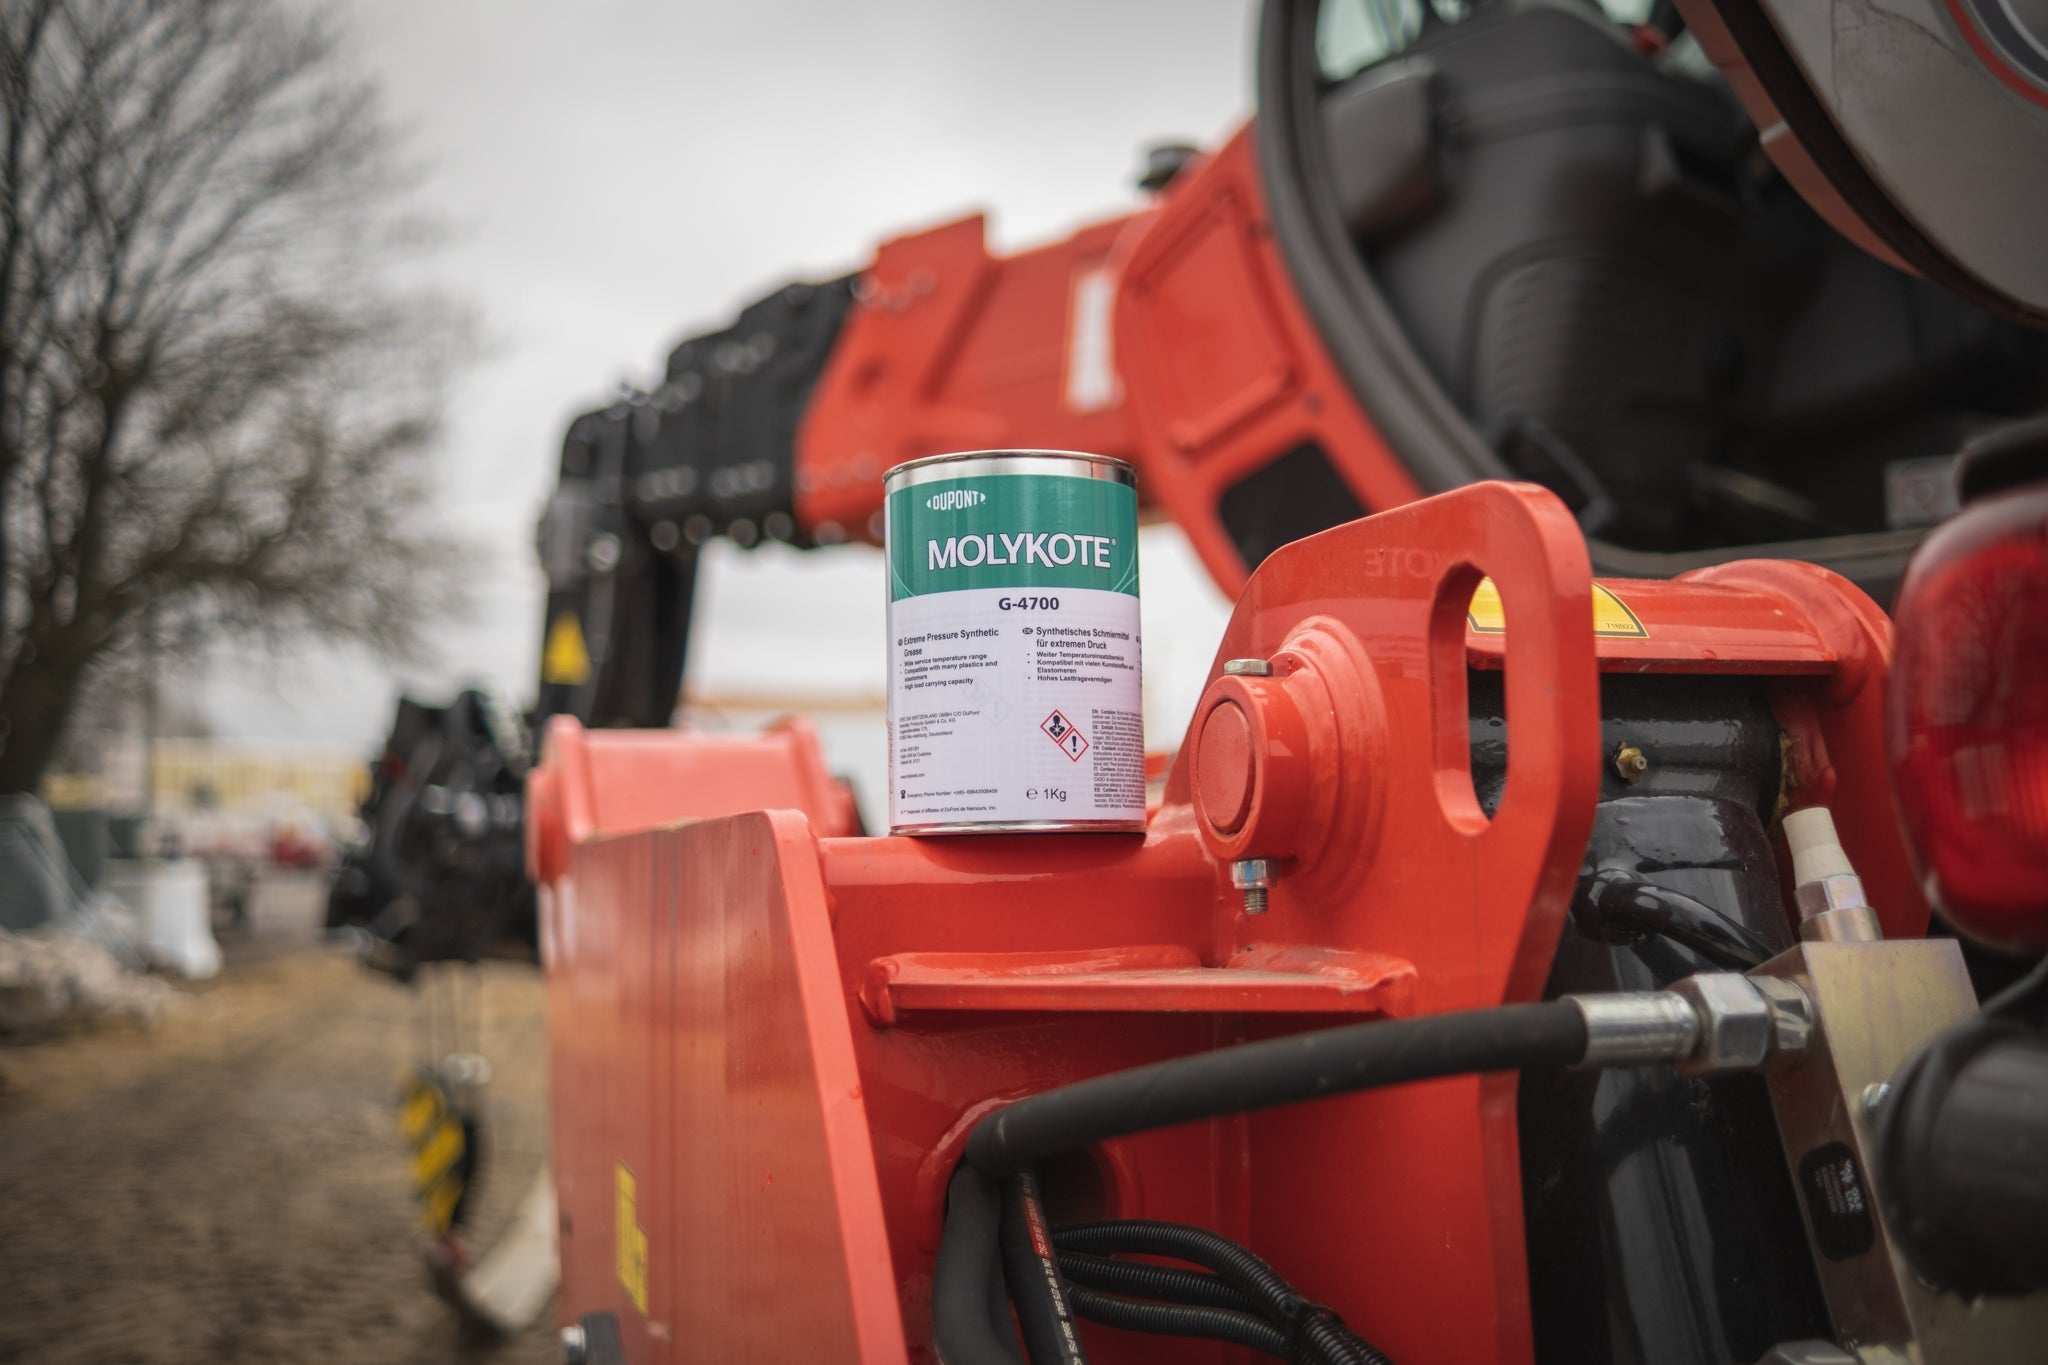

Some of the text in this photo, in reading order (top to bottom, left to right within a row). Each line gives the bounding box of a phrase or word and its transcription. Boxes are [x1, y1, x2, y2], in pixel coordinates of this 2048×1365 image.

[932, 489, 979, 511] DUPONT
[998, 597, 1060, 611] G-4700
[904, 636, 925, 646] Extreme
[927, 632, 958, 641] Pressure
[960, 628, 999, 640] Synthetic
[1036, 627, 1091, 637] Synthetisches
[1036, 638, 1049, 648] für
[1088, 641, 1107, 649] Druck
[904, 649, 922, 657] Grease
[1043, 788, 1067, 802] 1Kg
[1050, 1288, 1061, 1300] 275
[1054, 1300, 1067, 1316] BAR
[1067, 1339, 1079, 1354] PSI
